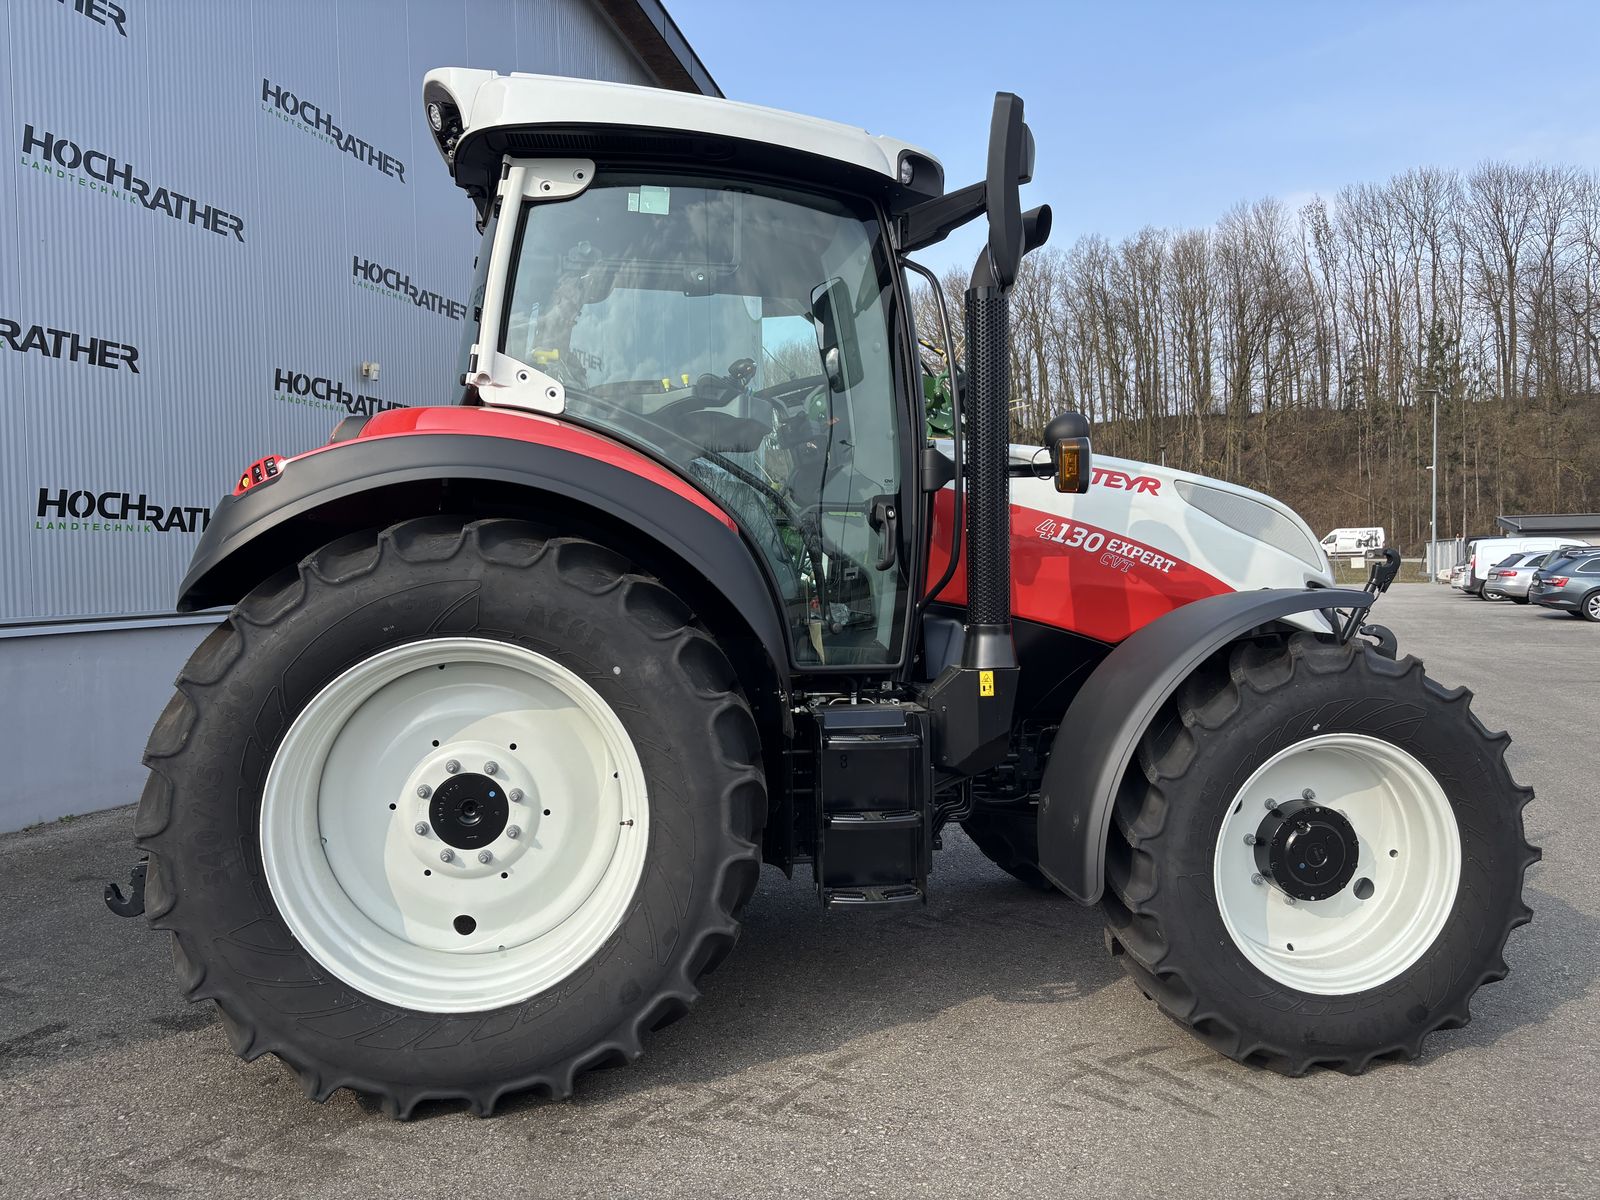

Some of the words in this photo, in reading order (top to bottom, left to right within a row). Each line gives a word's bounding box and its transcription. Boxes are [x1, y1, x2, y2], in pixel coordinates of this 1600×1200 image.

[57, 0, 127, 37] ER
[261, 104, 335, 146] LANDTECHNIK
[262, 78, 406, 184] HOCHRATHER
[21, 156, 137, 204] LANDTECHNIK
[22, 123, 245, 243] HOCHRATHER
[0, 317, 140, 374] RATHER
[273, 394, 345, 413] LANDTECHNIK
[274, 367, 411, 417] HOCHRATH
[1091, 467, 1162, 497] TEYR
[35, 521, 151, 533] LANDTECHNIK
[1035, 518, 1105, 553] 4130
[1106, 538, 1176, 573] EXPERT
[1100, 552, 1135, 573] CVT
